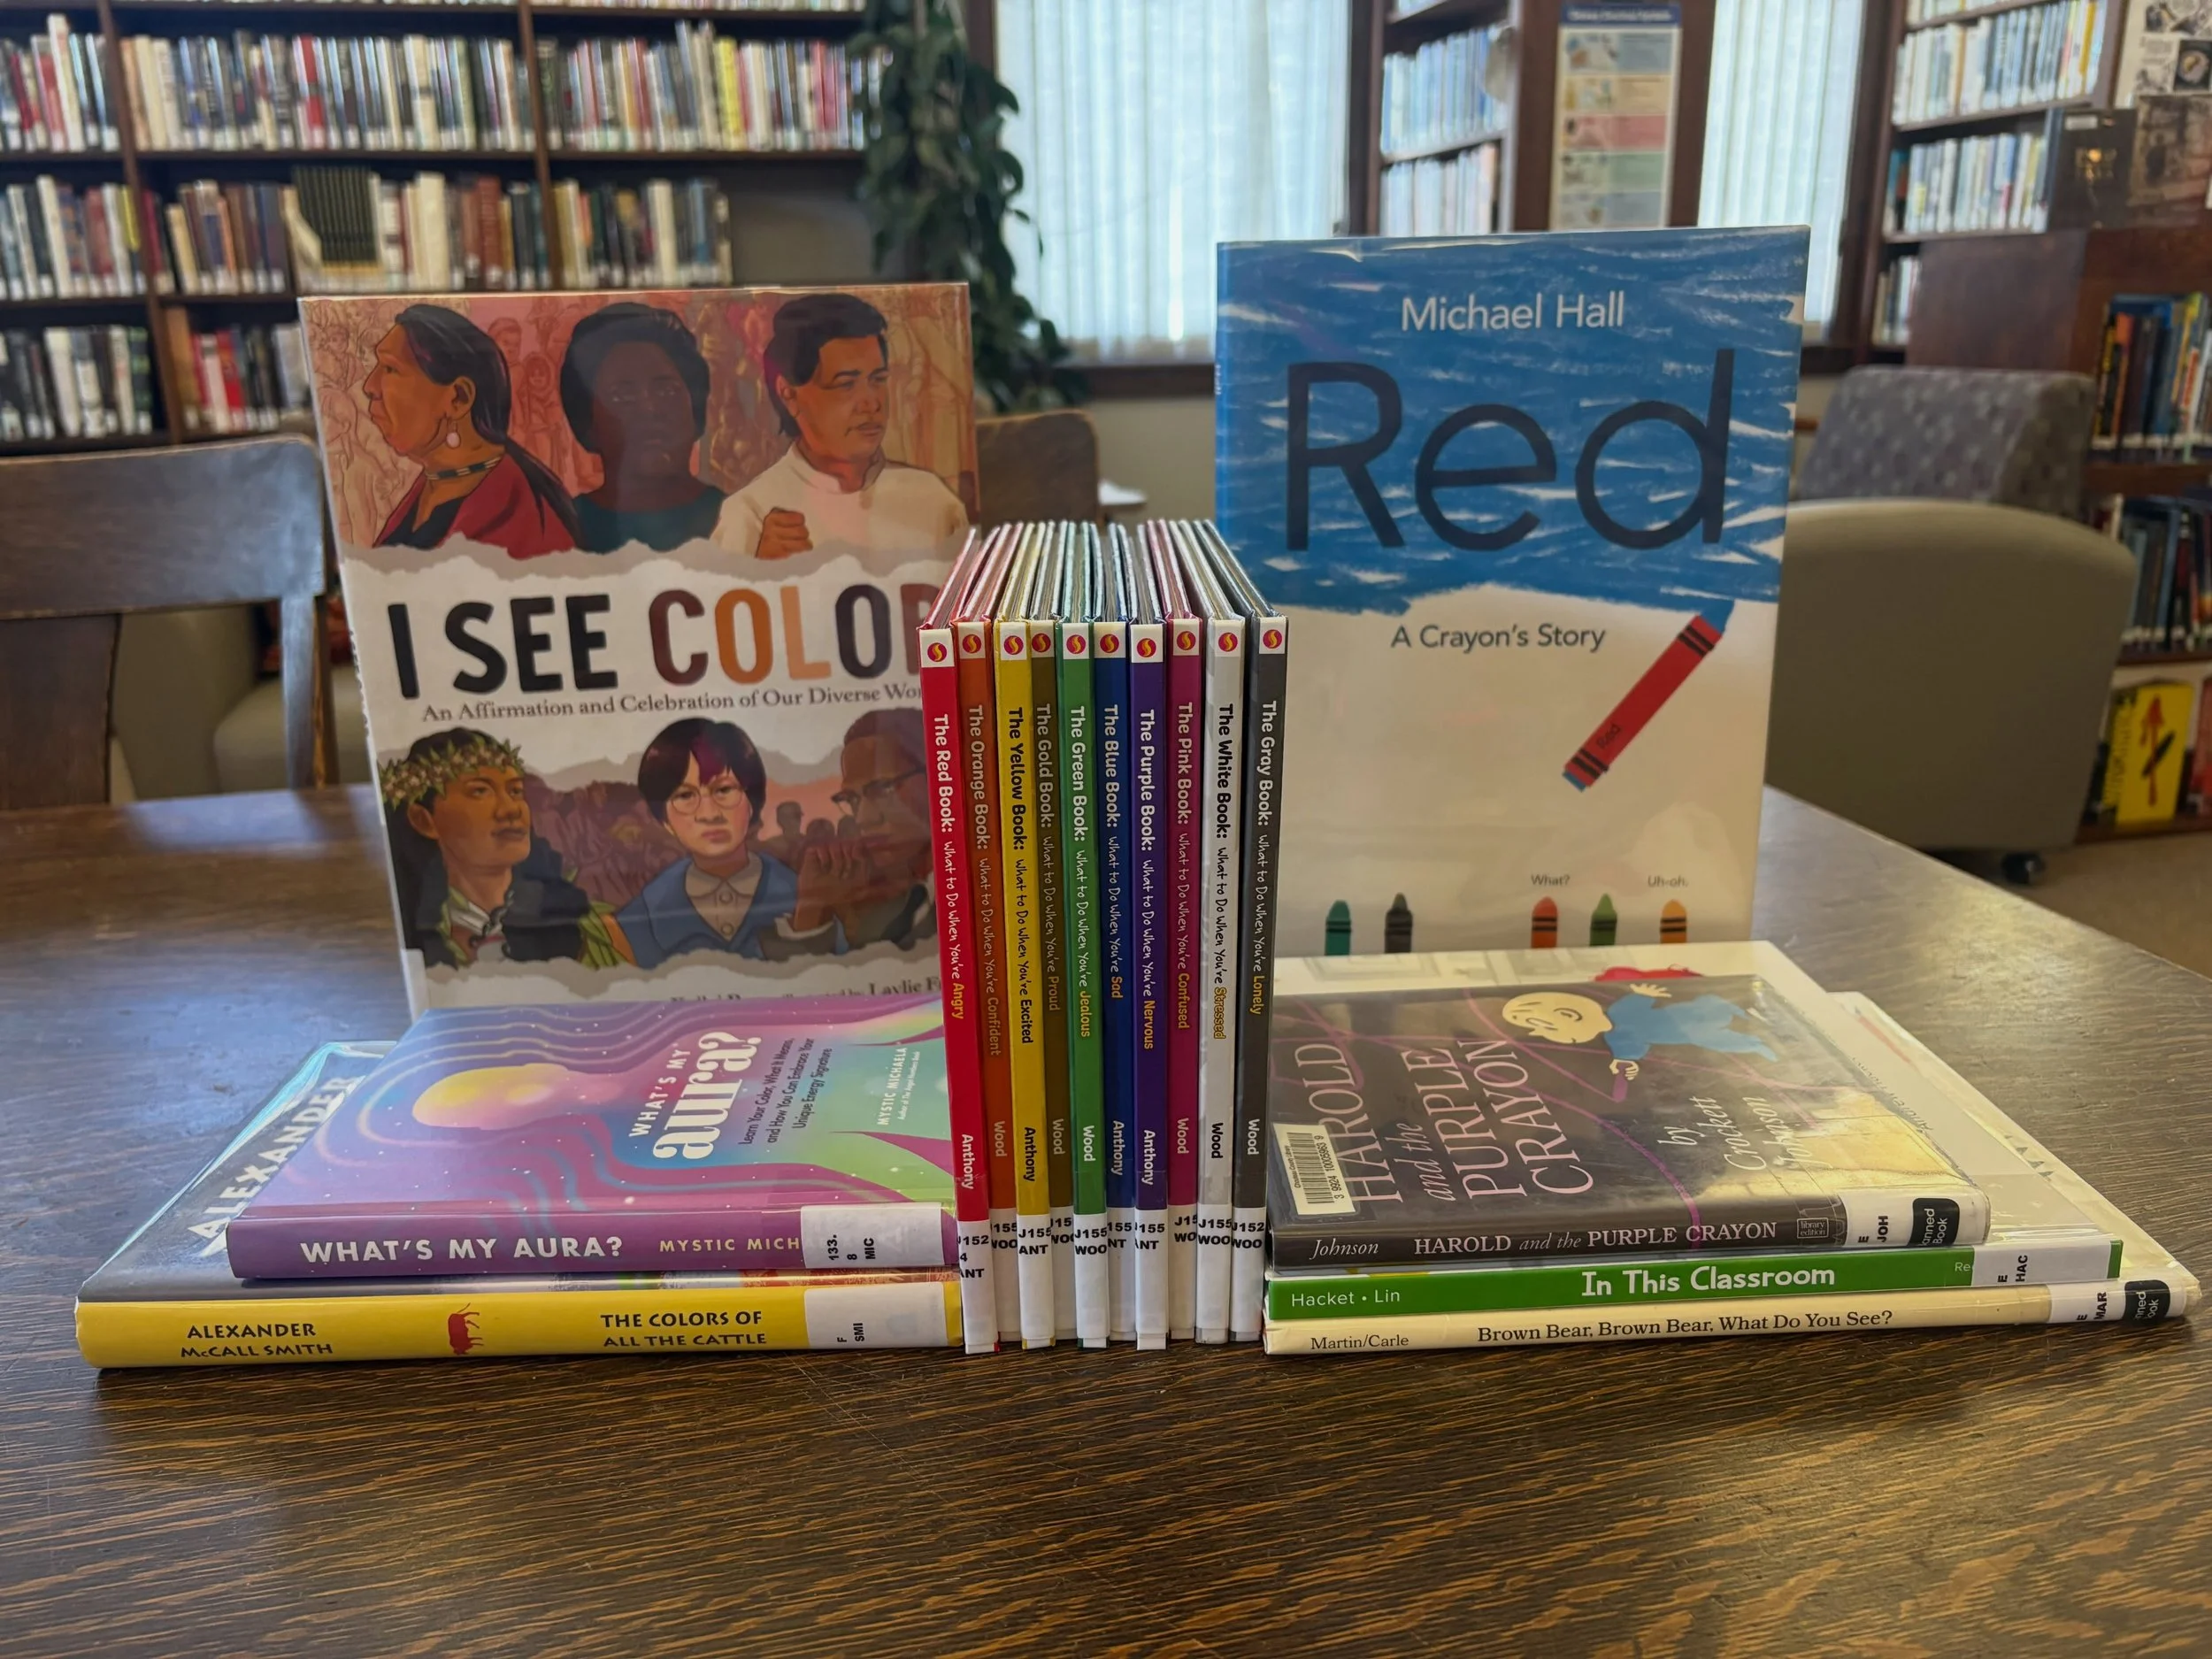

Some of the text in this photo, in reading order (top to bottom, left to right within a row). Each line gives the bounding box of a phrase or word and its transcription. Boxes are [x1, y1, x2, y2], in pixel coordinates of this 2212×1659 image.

[1402, 291, 1625, 332] Michael Hall
[1286, 349, 1735, 552] Red
[387, 603, 420, 699] I
[445, 593, 618, 695] SEE
[1390, 624, 1606, 653] A Crayon's Story
[422, 686, 881, 723] An Affirmation and Celebration of Our Diverse
[934, 714, 955, 833] The Red Book:
[969, 705, 989, 849] The Orange Book:
[1009, 707, 1027, 850] The Yellow Book:
[1037, 703, 1054, 828] The Gold Book:
[1071, 706, 1087, 841] The Green Book:
[1104, 704, 1118, 827] The Blue Book:
[1138, 710, 1155, 851] The Purple Book:
[1179, 703, 1193, 825] The Pink Book:
[1217, 703, 1233, 839] The White Book:
[1258, 701, 1277, 826] The Gray Book:
[1217, 884, 1228, 895] to
[1531, 874, 1571, 887] What?
[1216, 898, 1228, 912] Do
[1214, 949, 1228, 984] You're
[951, 983, 964, 1018] Angry
[1048, 976, 1060, 1010] Proud
[1111, 976, 1124, 998] Sad
[1178, 973, 1190, 1029] Confused
[1250, 975, 1265, 1015] Lonely
[987, 997, 1001, 1056] Confident
[1020, 999, 1033, 1043] Excited
[1079, 991, 1094, 1037] Jealous
[1144, 1000, 1155, 1049] Nervous
[1214, 987, 1226, 1039] Stressed
[629, 1049, 691, 1138] WHAT'S MY
[653, 1032, 762, 1160] aura?
[792, 1048, 833, 1129] Unique Energy Signature
[878, 1048, 907, 1125] MYSTIC MICHAELA
[738, 1106, 765, 1145] Learn Your
[765, 1079, 798, 1143] and How You Can
[1296, 1042, 1403, 1204] HAROLD
[1401, 1047, 1526, 1201] PURPLE
[1456, 1040, 1594, 1196] CRAYON
[995, 1121, 1007, 1156] Wood
[1053, 1118, 1064, 1155] Wood
[1083, 1125, 1096, 1162] Wood
[1111, 1120, 1125, 1175] Anthony
[1178, 1118, 1189, 1154] Wood
[1211, 1122, 1223, 1158] Wood
[1248, 1118, 1260, 1155] Wood
[1656, 1124, 1699, 1148] by
[1688, 1095, 1765, 1171] Crockett
[187, 1075, 357, 1240] ALEXANDER
[962, 1133, 975, 1189] Anthony
[1024, 1126, 1037, 1181] Anthony
[1141, 1130, 1156, 1185] Anthony
[1394, 1122, 1456, 1202] and the
[1198, 1235, 1231, 1245] WOO
[1310, 1222, 1778, 1260] Johnson HAROLD and the PURPLE CRAYON
[1800, 1228, 1826, 1237] edition
[1801, 1220, 1825, 1230] library
[1877, 1215, 1889, 1243] JOH
[1932, 1217, 1948, 1244] Book
[301, 1235, 623, 1263] WHAT'S MY AURA?
[659, 1239, 735, 1253] MYSTIC
[827, 1234, 839, 1261] 133.
[864, 1237, 875, 1260] MIC
[1019, 1245, 1048, 1255] ANT
[1075, 1245, 1107, 1255] WOO
[1581, 1265, 1835, 1297] In This Classroom
[1998, 1274, 2008, 1283] E
[2015, 1255, 2028, 1282] HAC
[1291, 1289, 1401, 1308] Hacket Lin
[2093, 1292, 2107, 1319] MAR
[187, 1322, 317, 1340] ALEXANDER
[601, 1310, 763, 1329] THE COLORS OF
[855, 1322, 864, 1342] SMI
[1310, 1310, 1893, 1350] Martin/Carle Brown Bear, Brown Bear, What Do You See?
[180, 1341, 334, 1359] McCALL SMITH
[603, 1332, 766, 1348] ALL THE CATTLE
